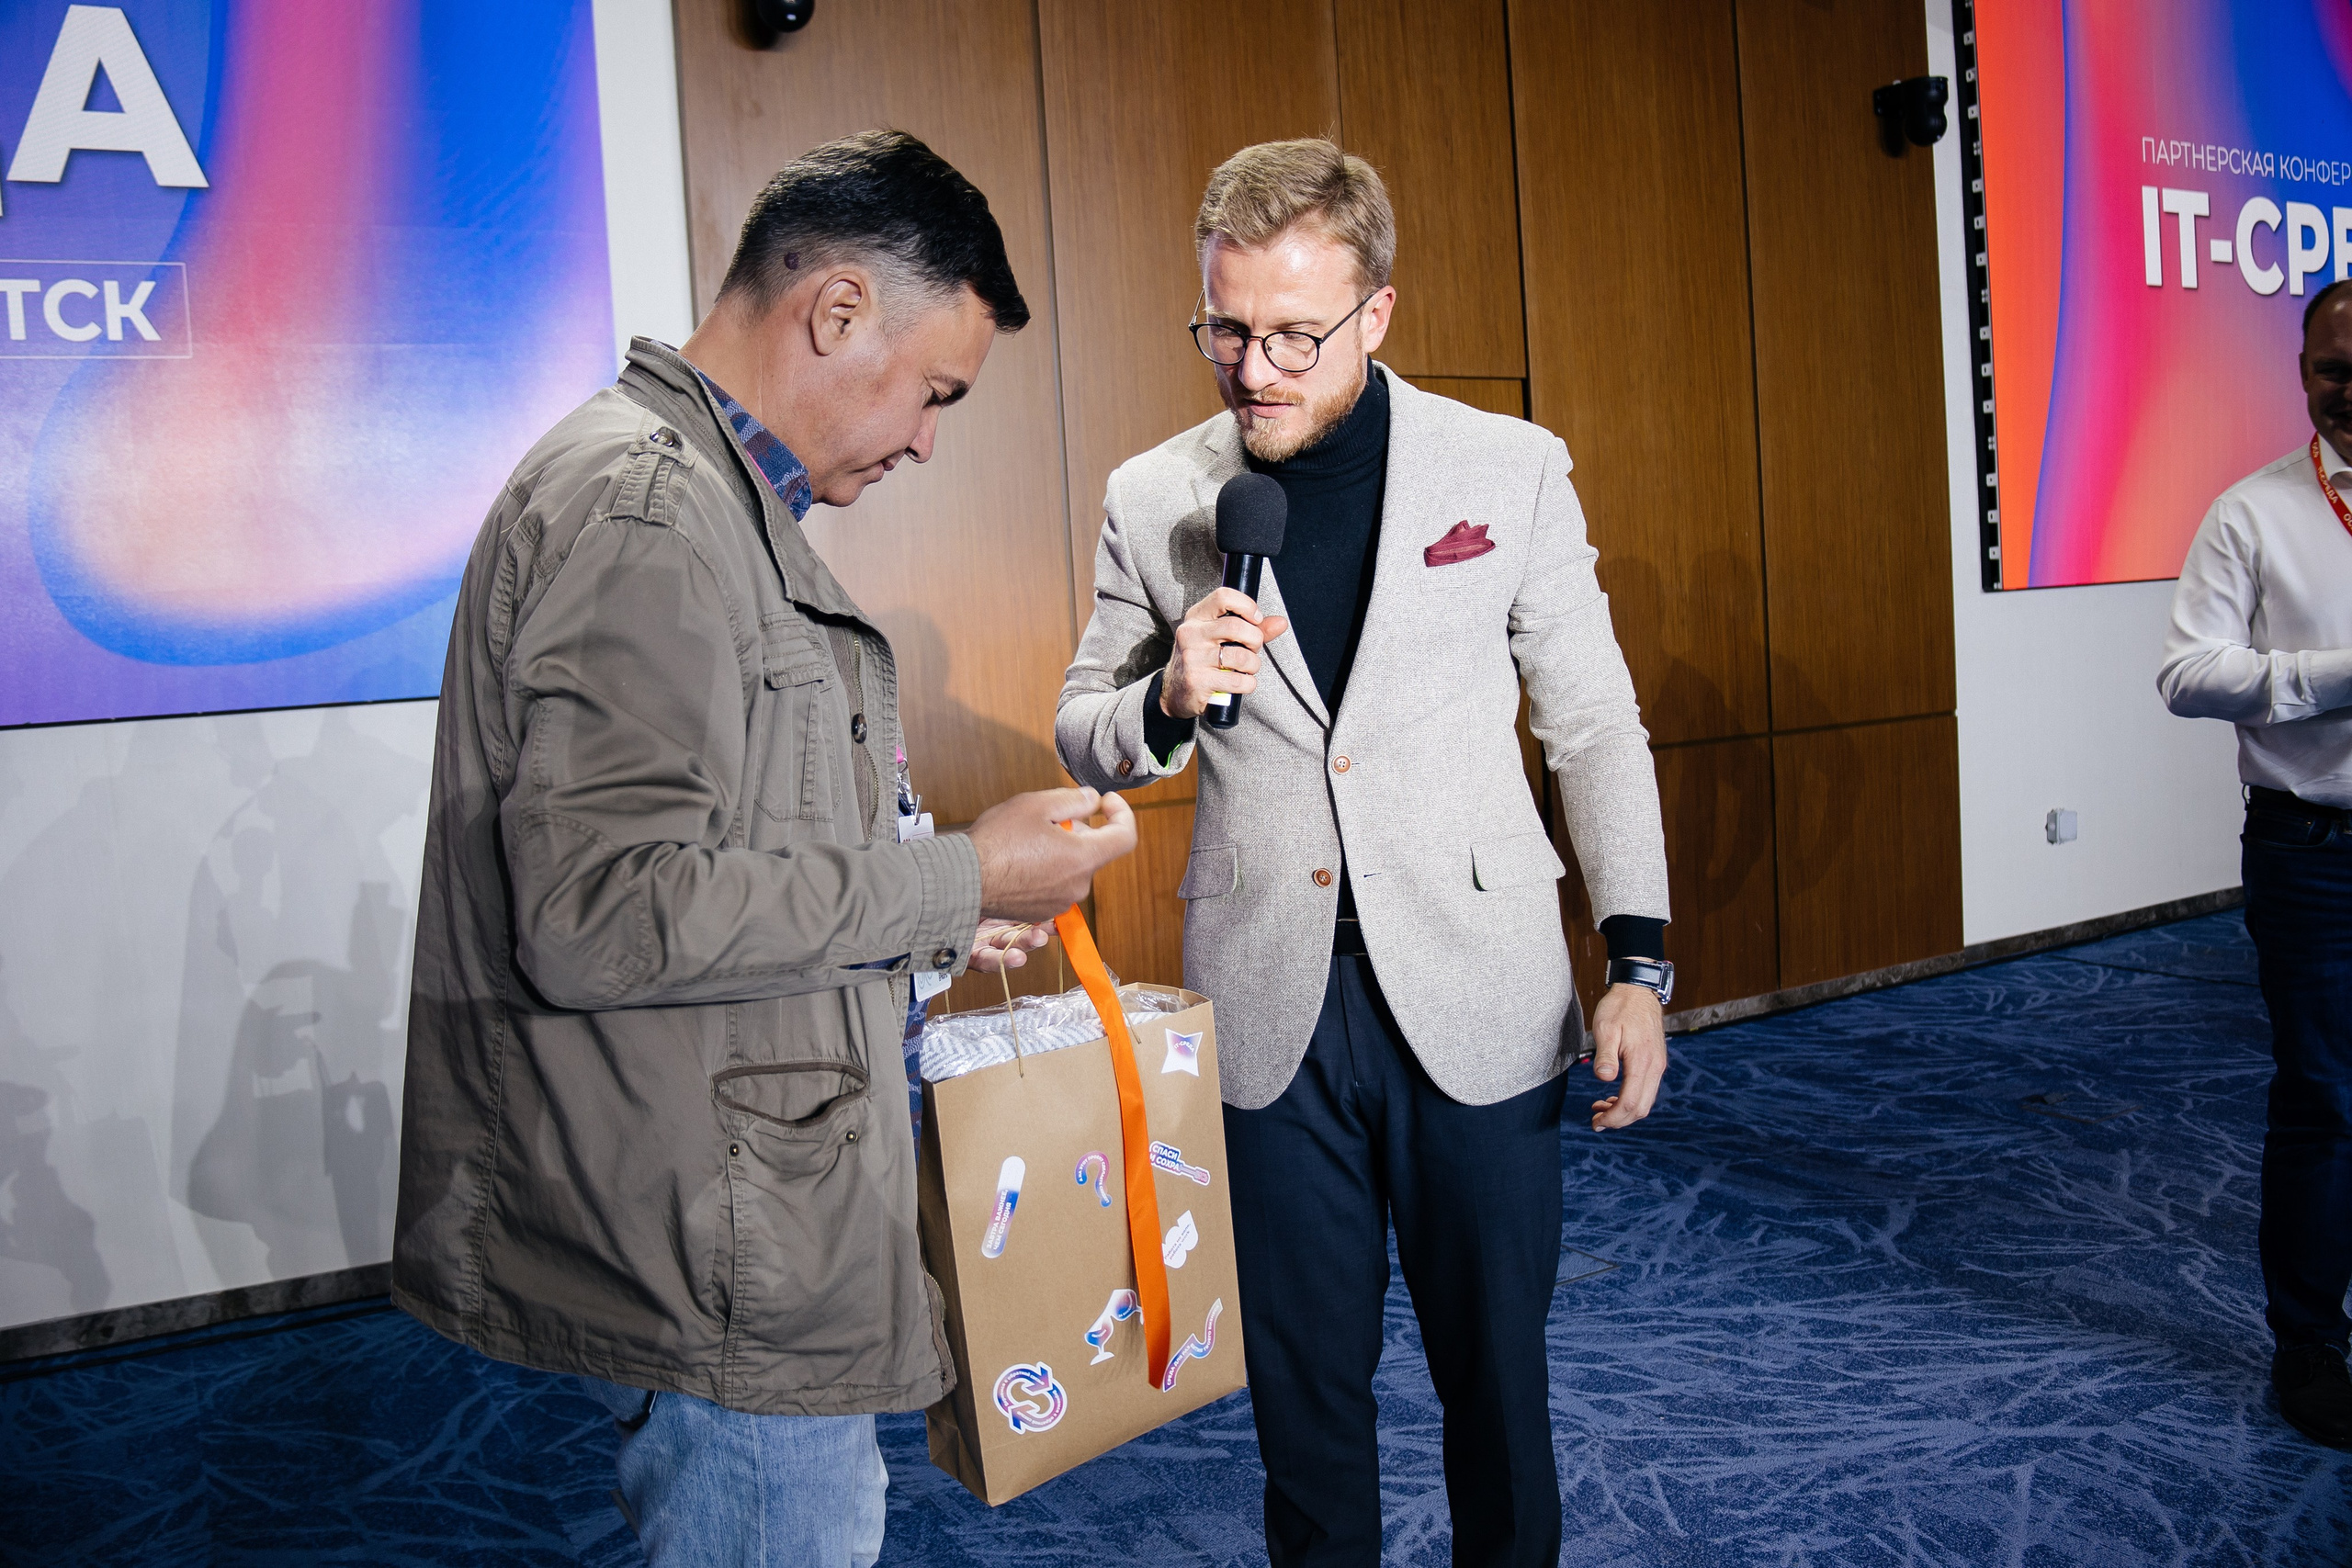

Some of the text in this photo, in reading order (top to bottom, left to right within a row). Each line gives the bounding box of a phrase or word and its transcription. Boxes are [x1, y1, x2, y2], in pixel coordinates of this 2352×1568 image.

[0, 4, 209, 217] А
[2142, 136, 2351, 186] ПАРТНЕРСКАЯ КОНФЕР
[0, 279, 162, 342] ТСК
[1149, 1153, 1156, 1162] И
[1152, 1145, 1178, 1159] СПАСИ
[987, 1222, 999, 1249] ЗАВТРА
[993, 1201, 1012, 1250] ЧЕМ СЕГОДНЯ
[1167, 1366, 1175, 1386] СРЕДА
[1173, 1355, 1183, 1366] ДЛЯ
